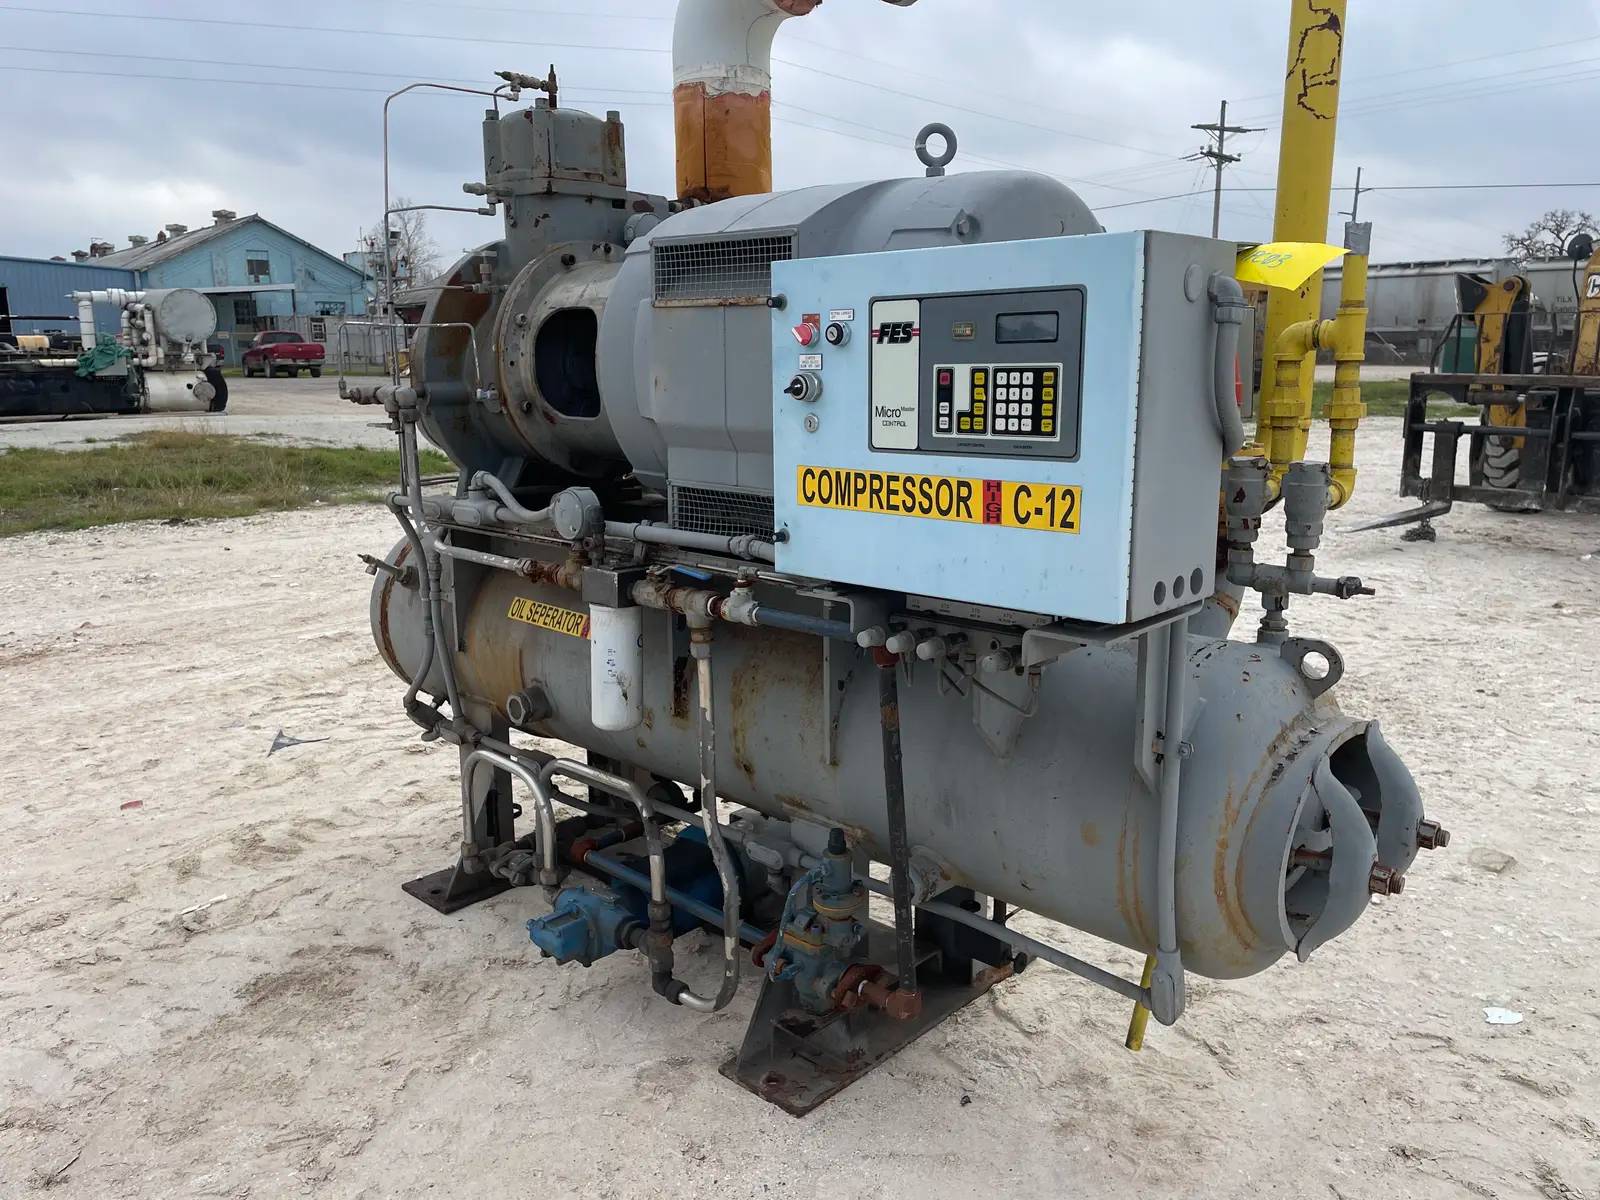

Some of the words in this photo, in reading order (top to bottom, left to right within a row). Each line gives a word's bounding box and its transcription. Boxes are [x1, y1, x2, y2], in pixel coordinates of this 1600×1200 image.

[876, 321, 915, 344] FES
[875, 405, 901, 418] Micro
[882, 420, 907, 428] CONTROL
[802, 468, 973, 519] COMPRESSOR
[986, 482, 1001, 523] HIGH
[1013, 484, 1075, 529] C-12
[511, 599, 526, 619] OIL
[526, 602, 584, 635] SEPERATOR
